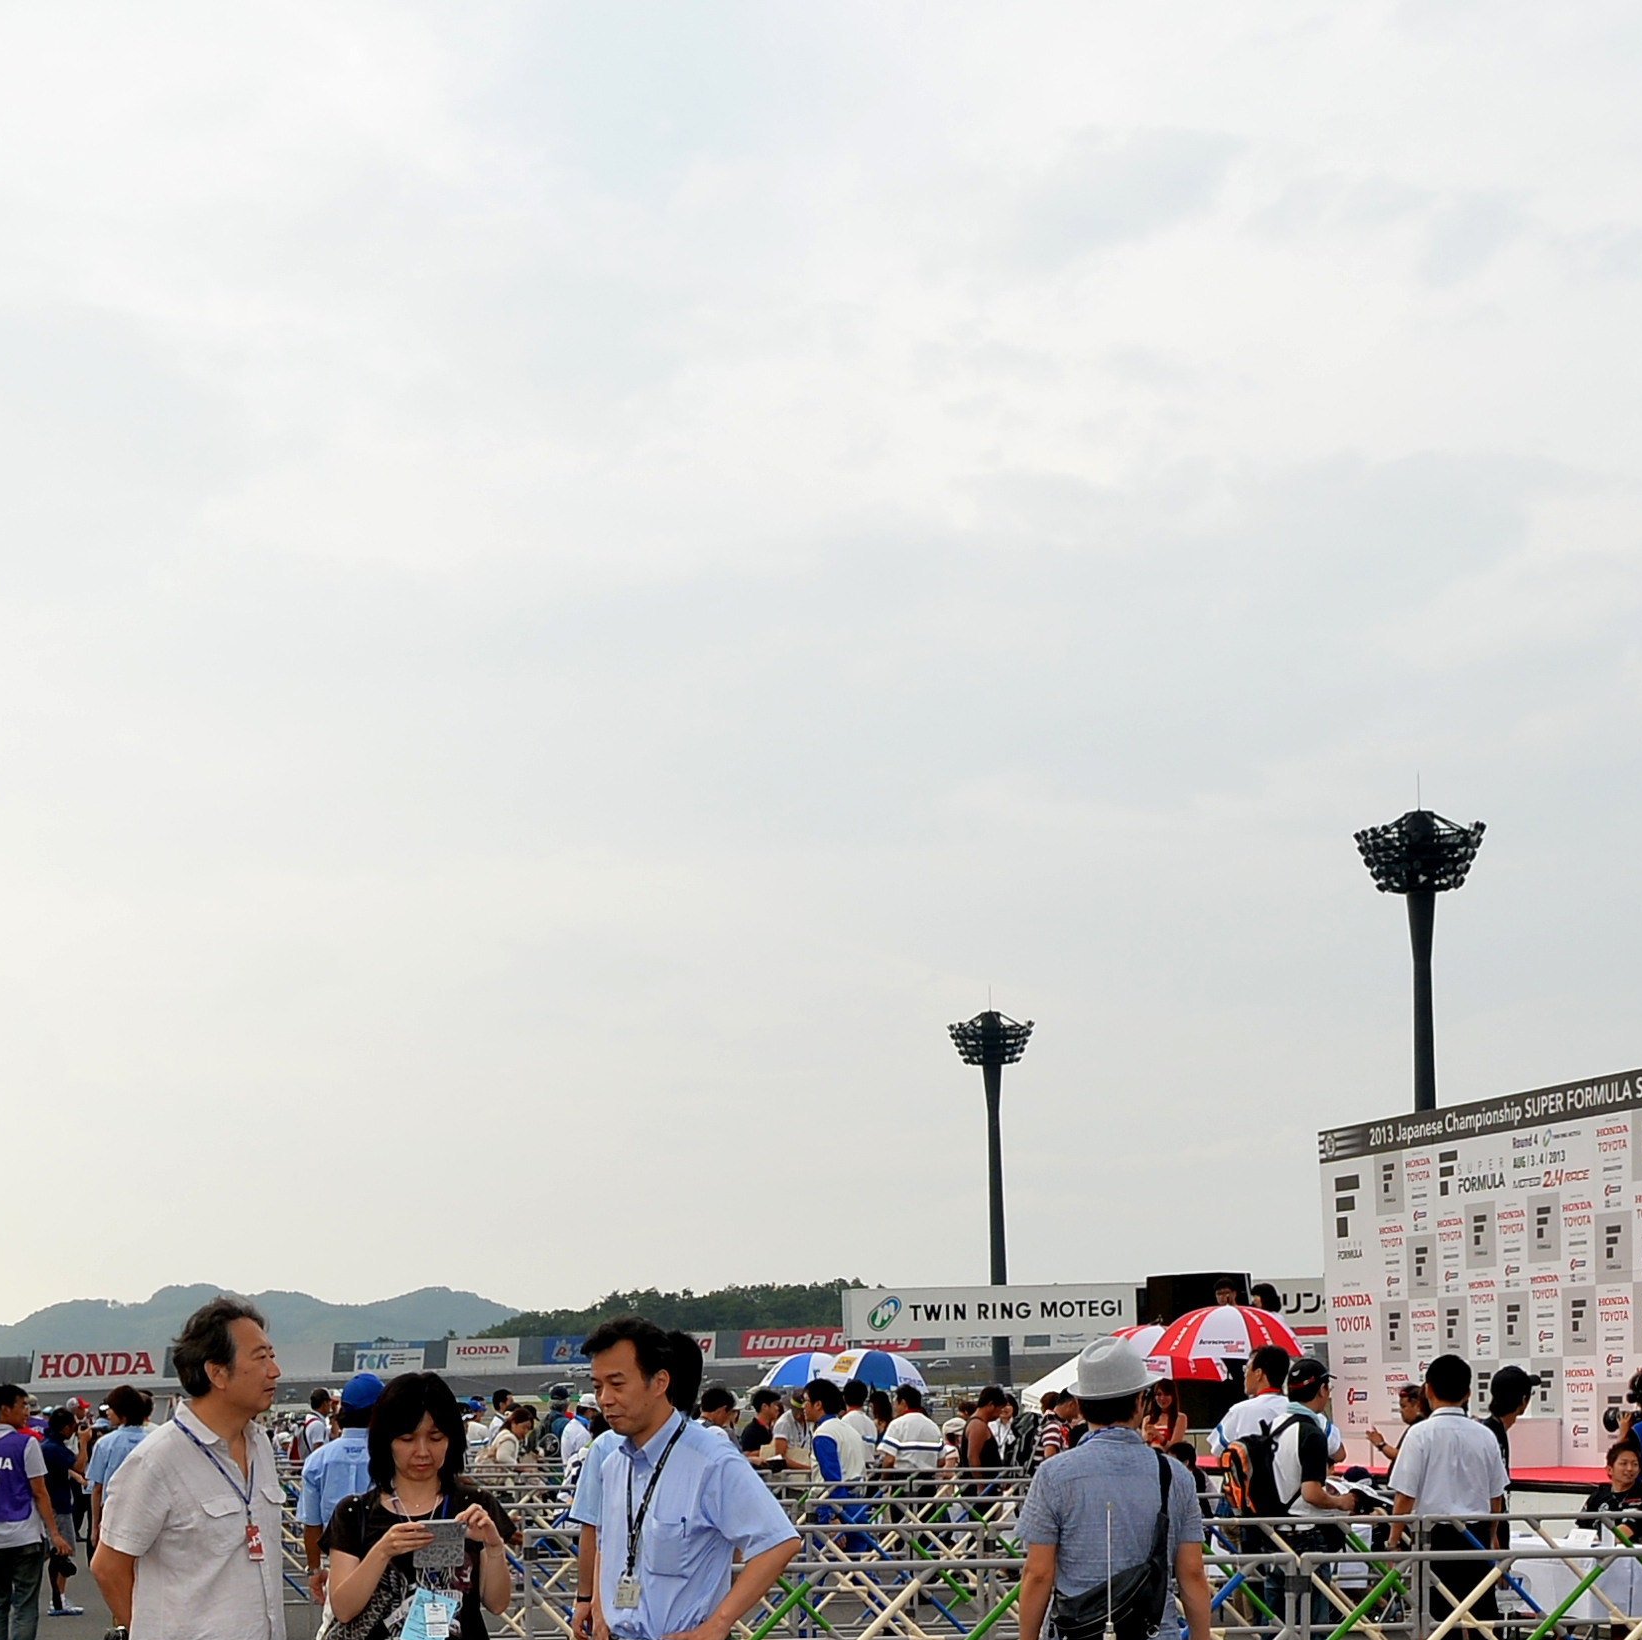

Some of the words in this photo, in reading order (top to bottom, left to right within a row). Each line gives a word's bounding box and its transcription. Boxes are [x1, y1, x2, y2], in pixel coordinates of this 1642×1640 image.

[1369, 1124, 1394, 1147] 2013
[1396, 1120, 1443, 1146] Japanese
[1444, 1100, 1522, 1134] Championship
[1524, 1092, 1564, 1119] SUPER
[1567, 1079, 1632, 1109] FORMULA
[1596, 1124, 1629, 1138] HONDA
[1598, 1139, 1628, 1153] TOYOTA
[1458, 1172, 1506, 1195] FORMULA
[1562, 1201, 1592, 1213] HONDA
[1332, 1293, 1372, 1308] HONDA
[1598, 1296, 1630, 1307] HONDA
[909, 1303, 966, 1322] TWIN
[977, 1302, 1031, 1321] RING
[1040, 1299, 1123, 1319] MOTEGI
[1335, 1315, 1372, 1332] TOYOTA
[746, 1333, 825, 1350] Honda
[455, 1345, 510, 1356] HONDA
[38, 1351, 156, 1379] HONDA
[1565, 1368, 1595, 1378] HONDA
